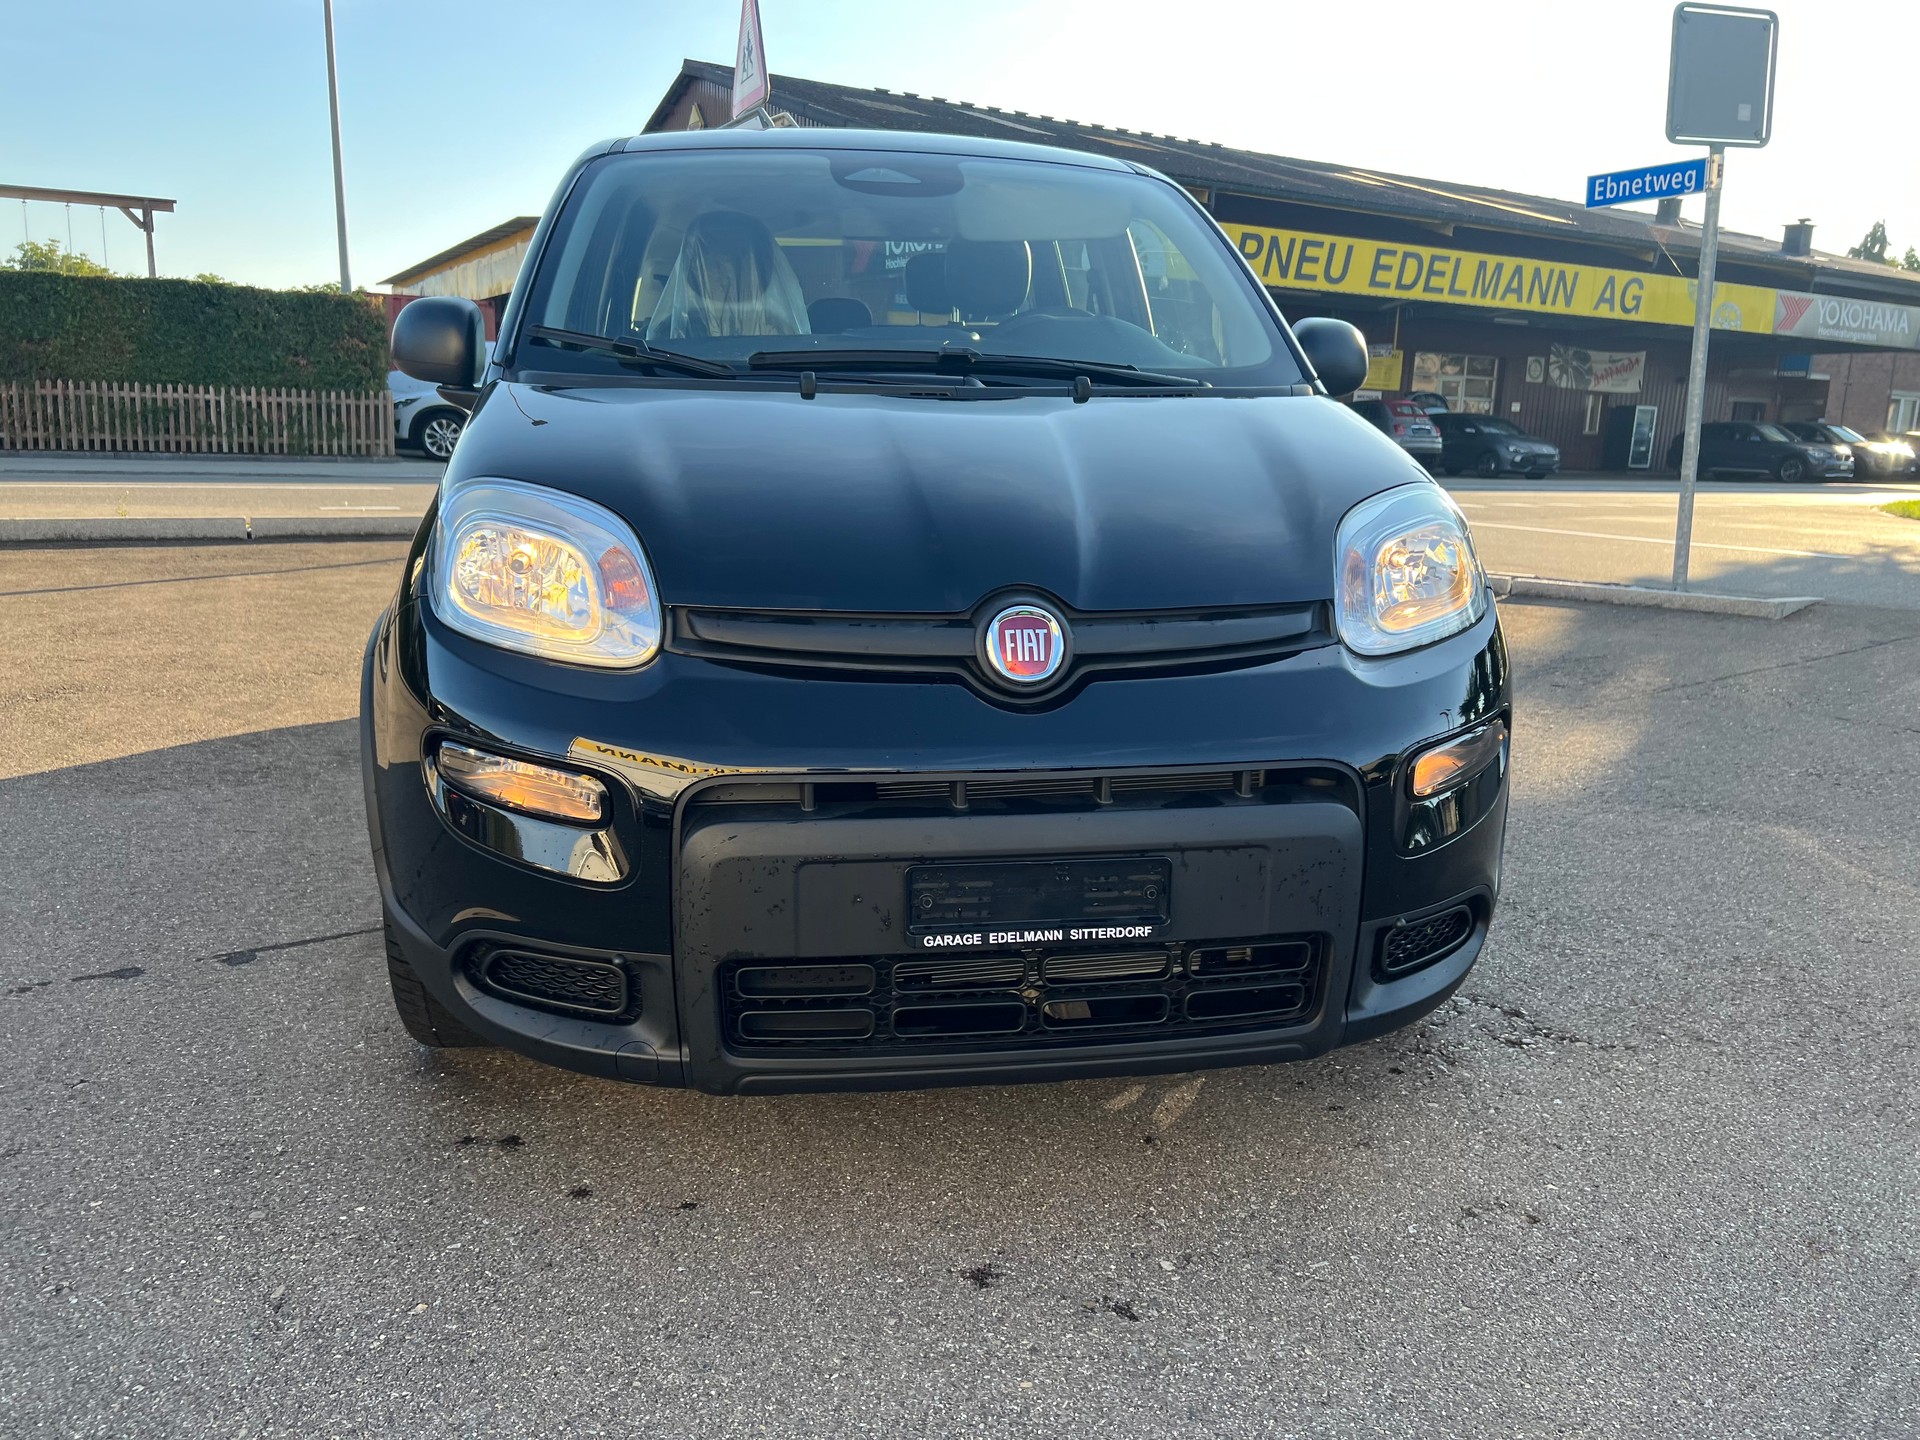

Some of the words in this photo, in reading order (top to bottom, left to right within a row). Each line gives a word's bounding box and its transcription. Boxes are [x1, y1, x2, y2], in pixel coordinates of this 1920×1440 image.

[1594, 169, 1697, 201] Ebnetweg
[1238, 232, 1354, 285] PNEU
[1368, 248, 1579, 308] EDELMANN
[1593, 275, 1644, 315] AG
[1818, 299, 1909, 334] YOKOHAMA
[1004, 629, 1047, 662] FIAT
[923, 933, 982, 947] GARAGE
[989, 929, 1063, 944] EDELMANN
[1069, 926, 1153, 940] SITTERDORF
